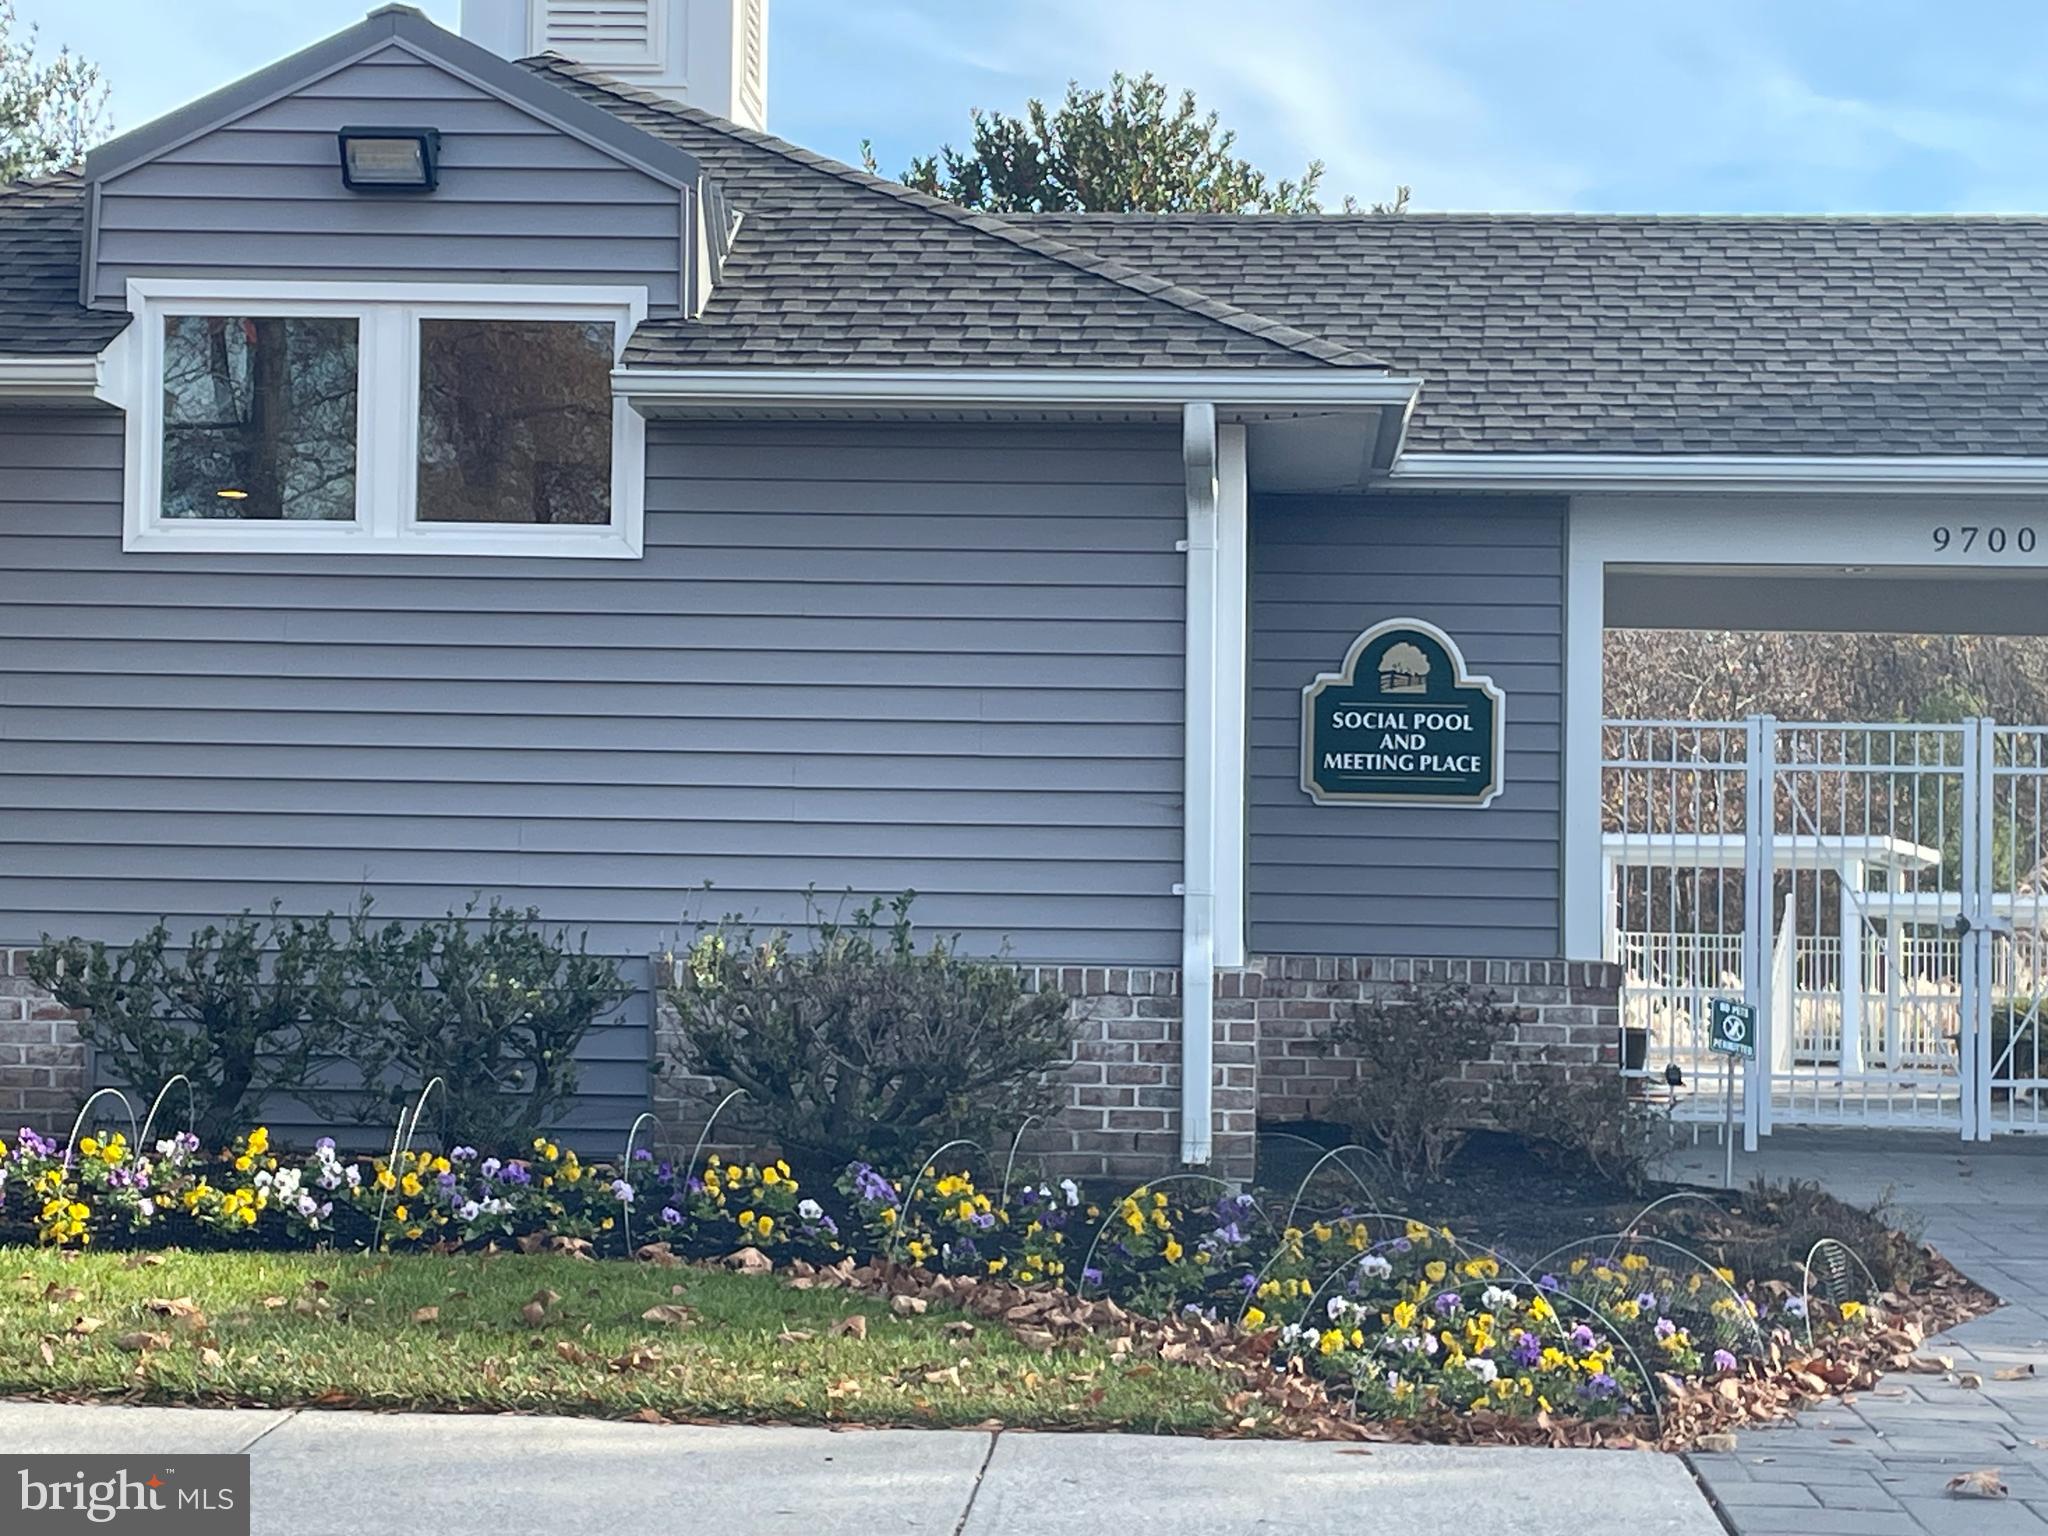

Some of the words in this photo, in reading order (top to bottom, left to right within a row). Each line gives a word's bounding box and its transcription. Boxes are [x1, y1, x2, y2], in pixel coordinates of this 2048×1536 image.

[1932, 526, 2036, 553] 9700
[1332, 712, 1408, 730] SOCIAL
[1414, 713, 1474, 731] POOL
[1379, 734, 1426, 751] AND
[1323, 753, 1414, 771] MEETING
[1419, 755, 1481, 772] PLACE
